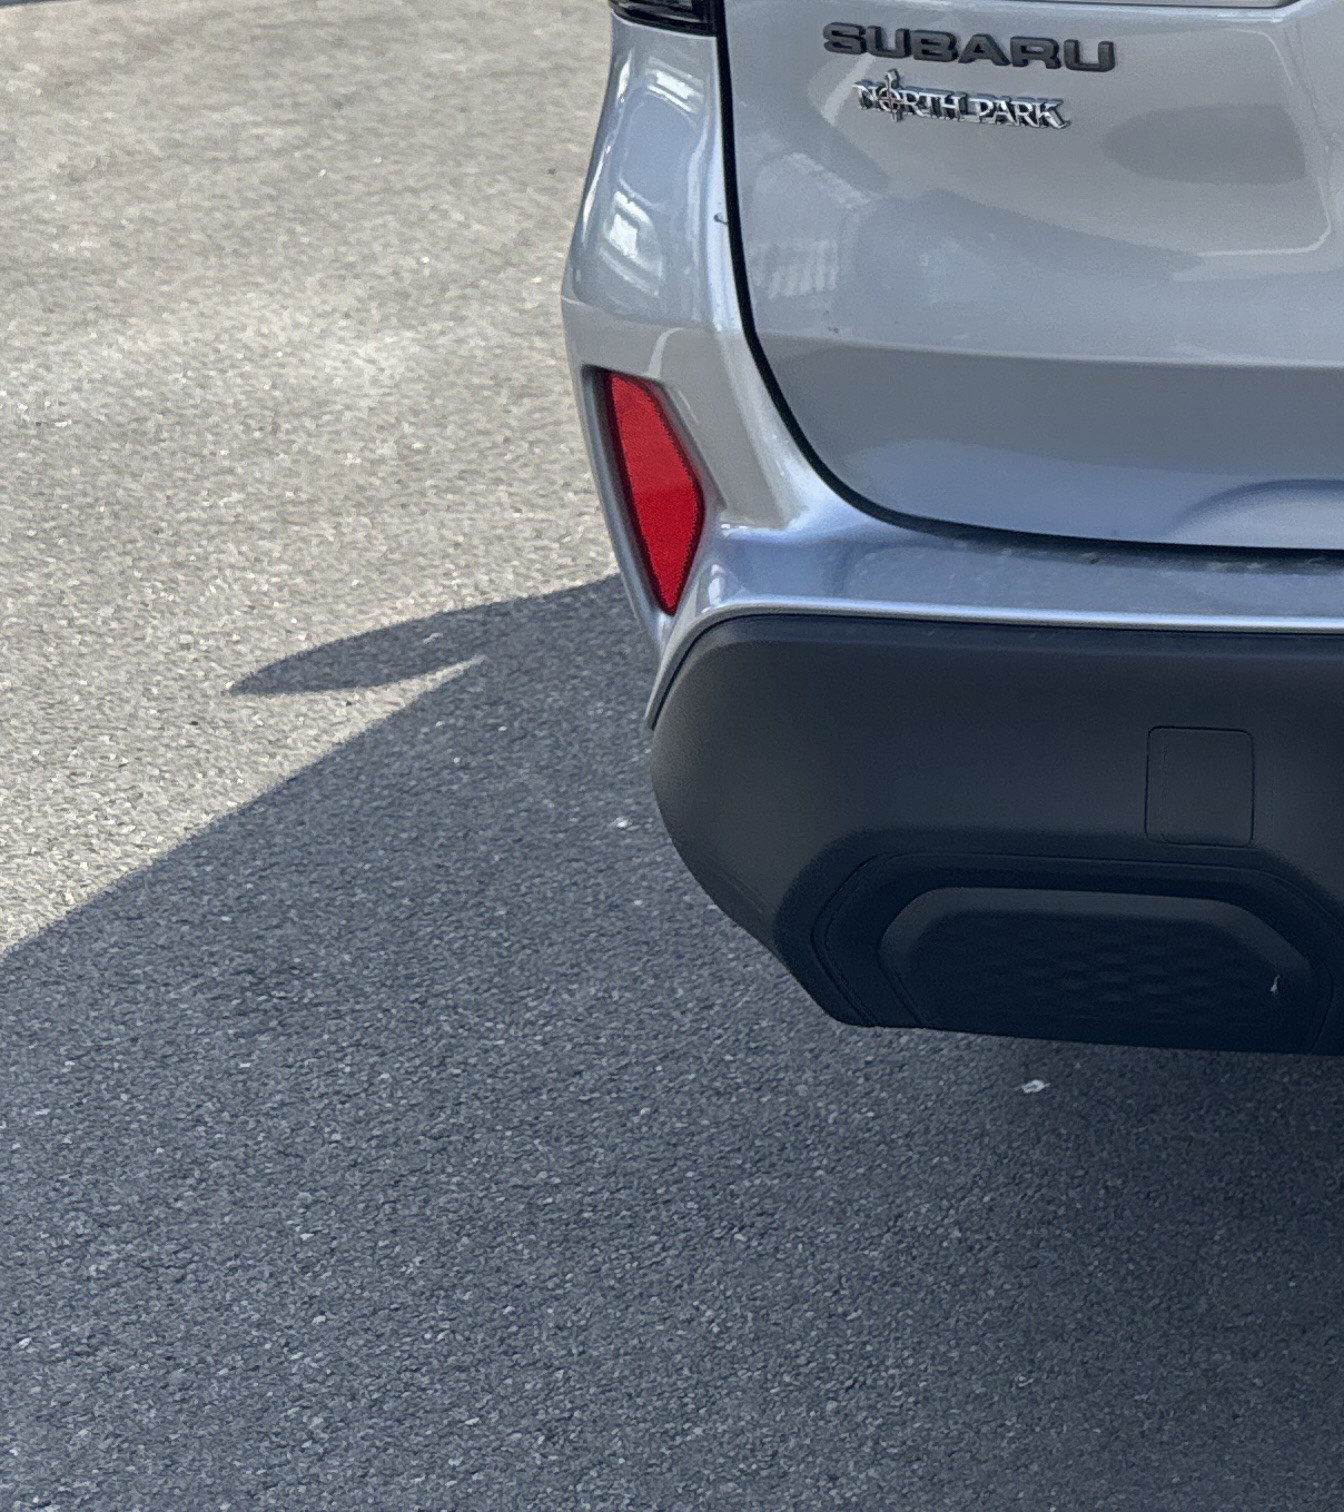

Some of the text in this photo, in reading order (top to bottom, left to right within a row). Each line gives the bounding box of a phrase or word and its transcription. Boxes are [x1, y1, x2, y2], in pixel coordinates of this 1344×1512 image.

[823, 22, 1116, 72] SUBARU
[852, 69, 1074, 129] NORTH PARK
